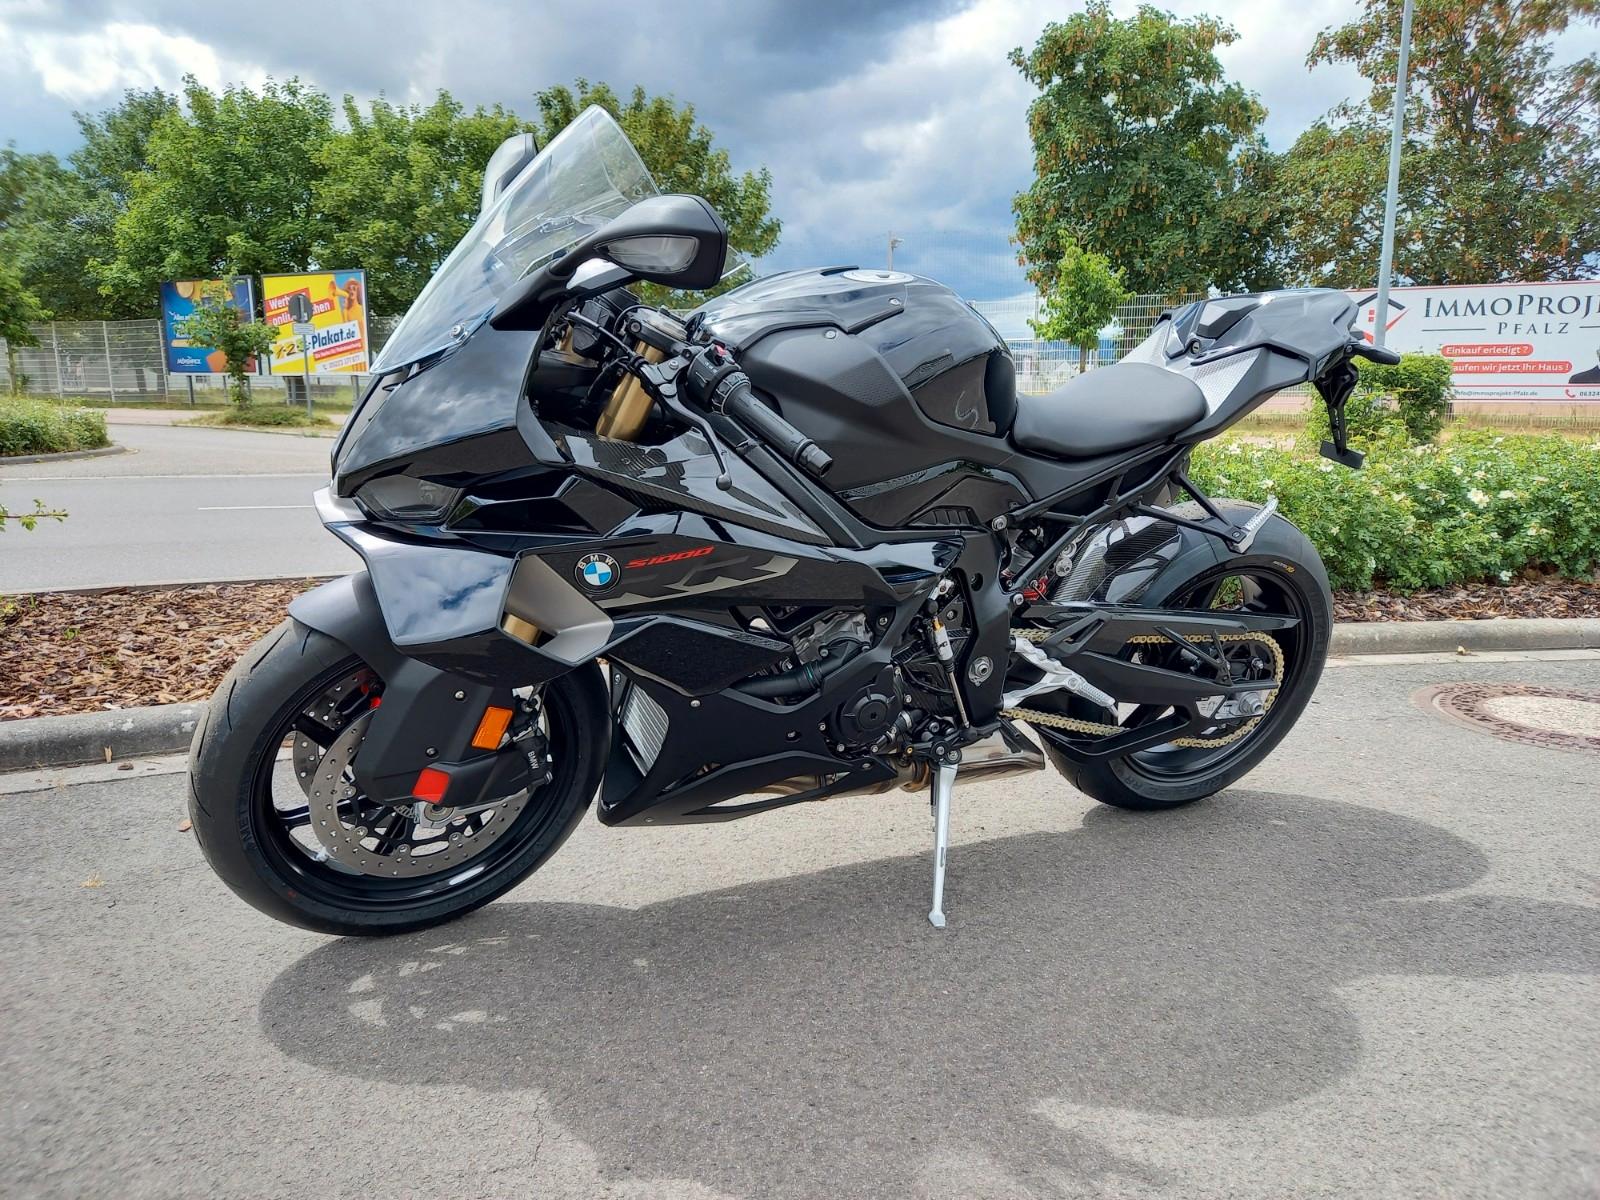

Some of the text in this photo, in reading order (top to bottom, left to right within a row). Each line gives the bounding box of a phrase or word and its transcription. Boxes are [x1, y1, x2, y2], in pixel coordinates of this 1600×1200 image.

[1446, 346, 1481, 354] Einkauf
[1483, 345, 1521, 355] erledigt
[1453, 363, 1480, 372] aufen
[1482, 363, 1497, 371] wir
[1498, 363, 1521, 373] jetzt
[1522, 363, 1538, 371] Ihr
[1539, 363, 1564, 371] Haus
[527, 750, 539, 769] BMW
